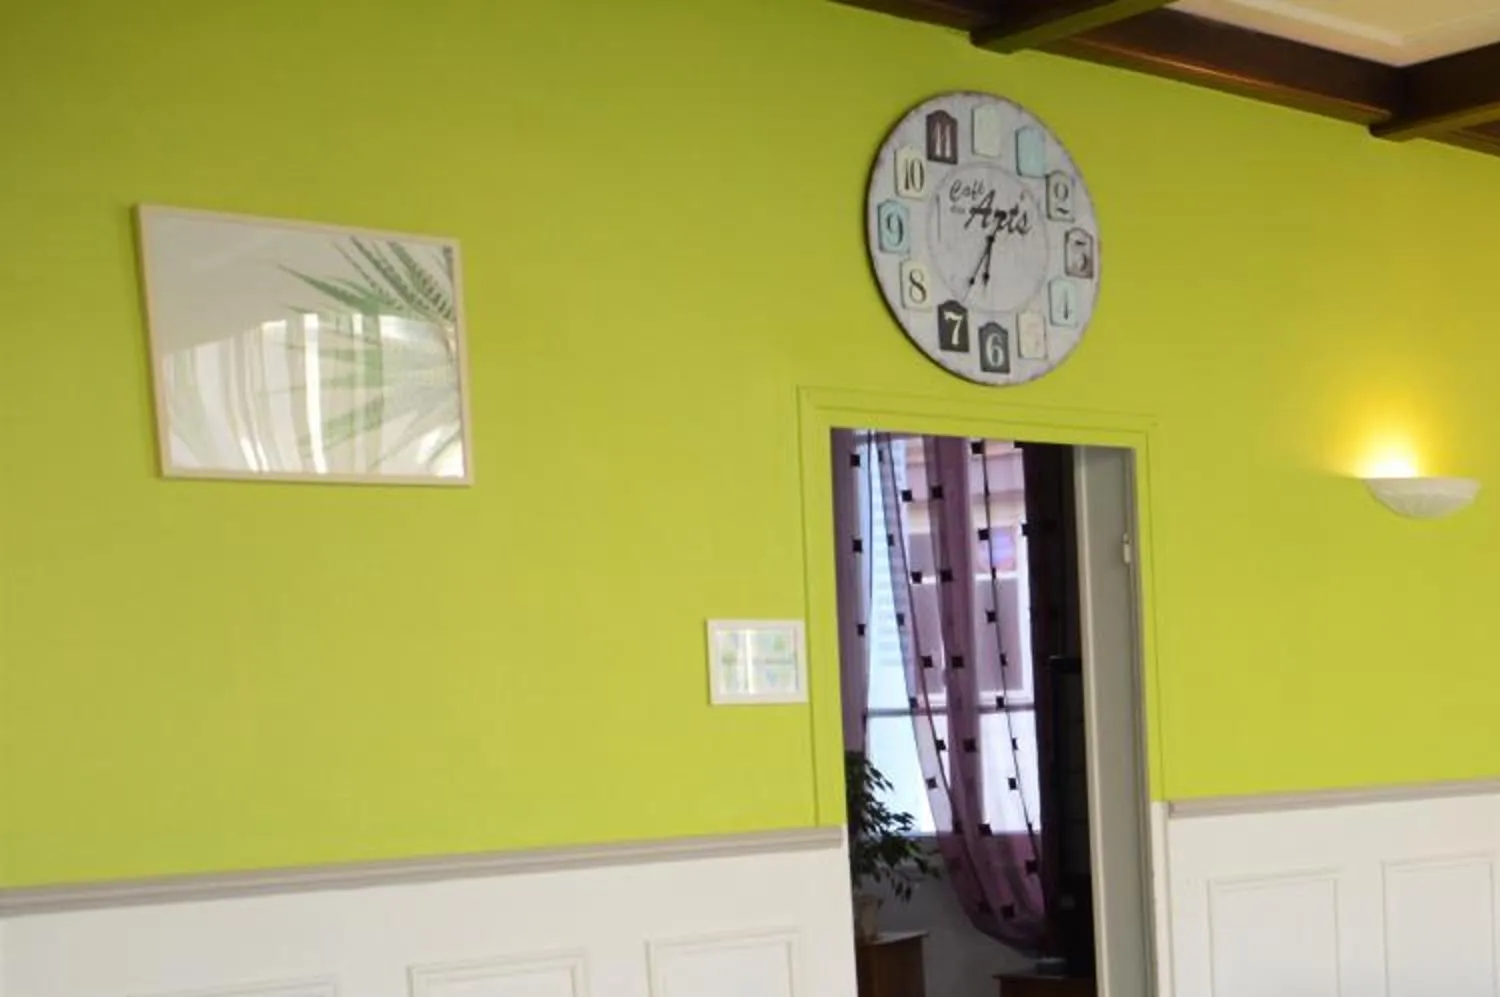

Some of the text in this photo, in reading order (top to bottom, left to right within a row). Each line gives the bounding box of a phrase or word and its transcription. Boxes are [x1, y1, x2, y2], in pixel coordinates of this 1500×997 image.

[903, 158, 925, 193] 10
[909, 268, 927, 304] 8
[943, 311, 963, 346] 7
[985, 332, 1005, 367] 6
